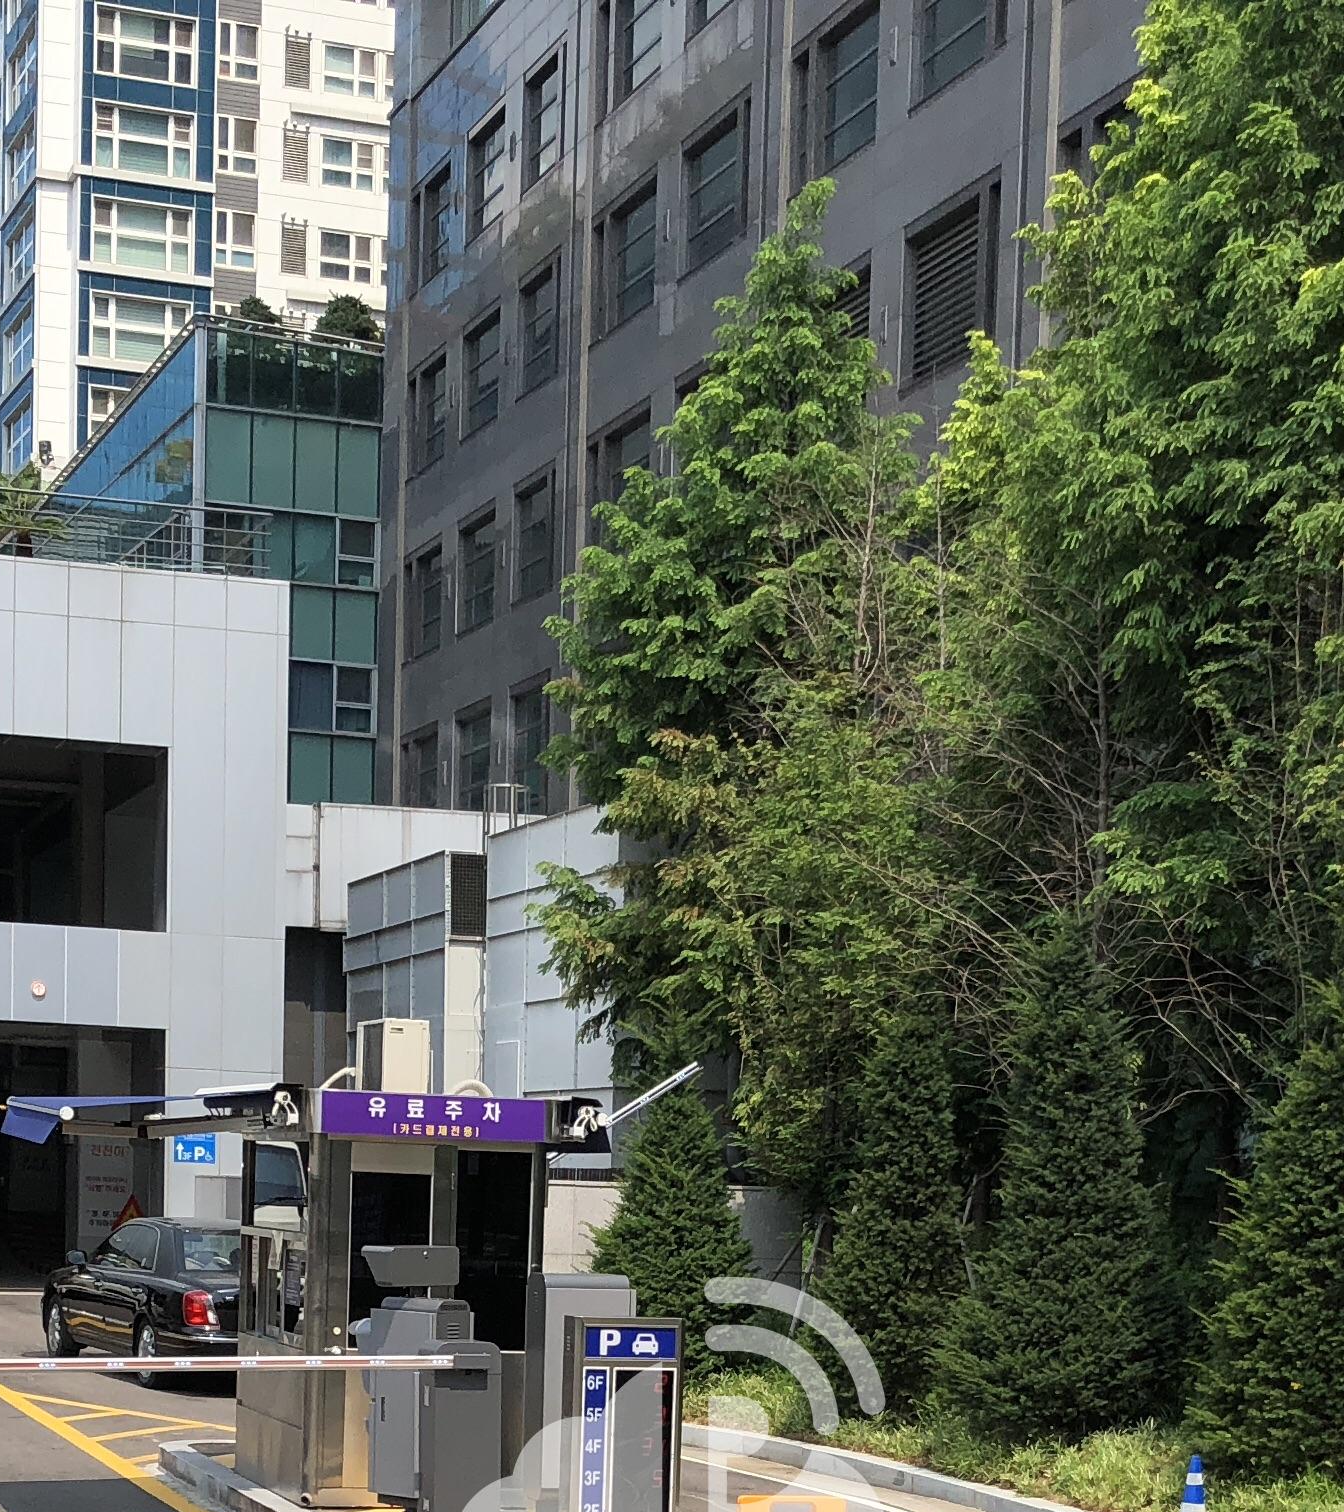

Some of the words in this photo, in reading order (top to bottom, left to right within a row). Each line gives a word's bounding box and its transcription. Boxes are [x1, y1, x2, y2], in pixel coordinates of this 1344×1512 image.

[194, 1146, 206, 1161] P
[599, 1329, 622, 1356] P
[586, 1375, 605, 1391] 6F
[585, 1407, 603, 1423] 5F
[584, 1439, 602, 1454] 4F
[584, 1471, 601, 1486] 3F
